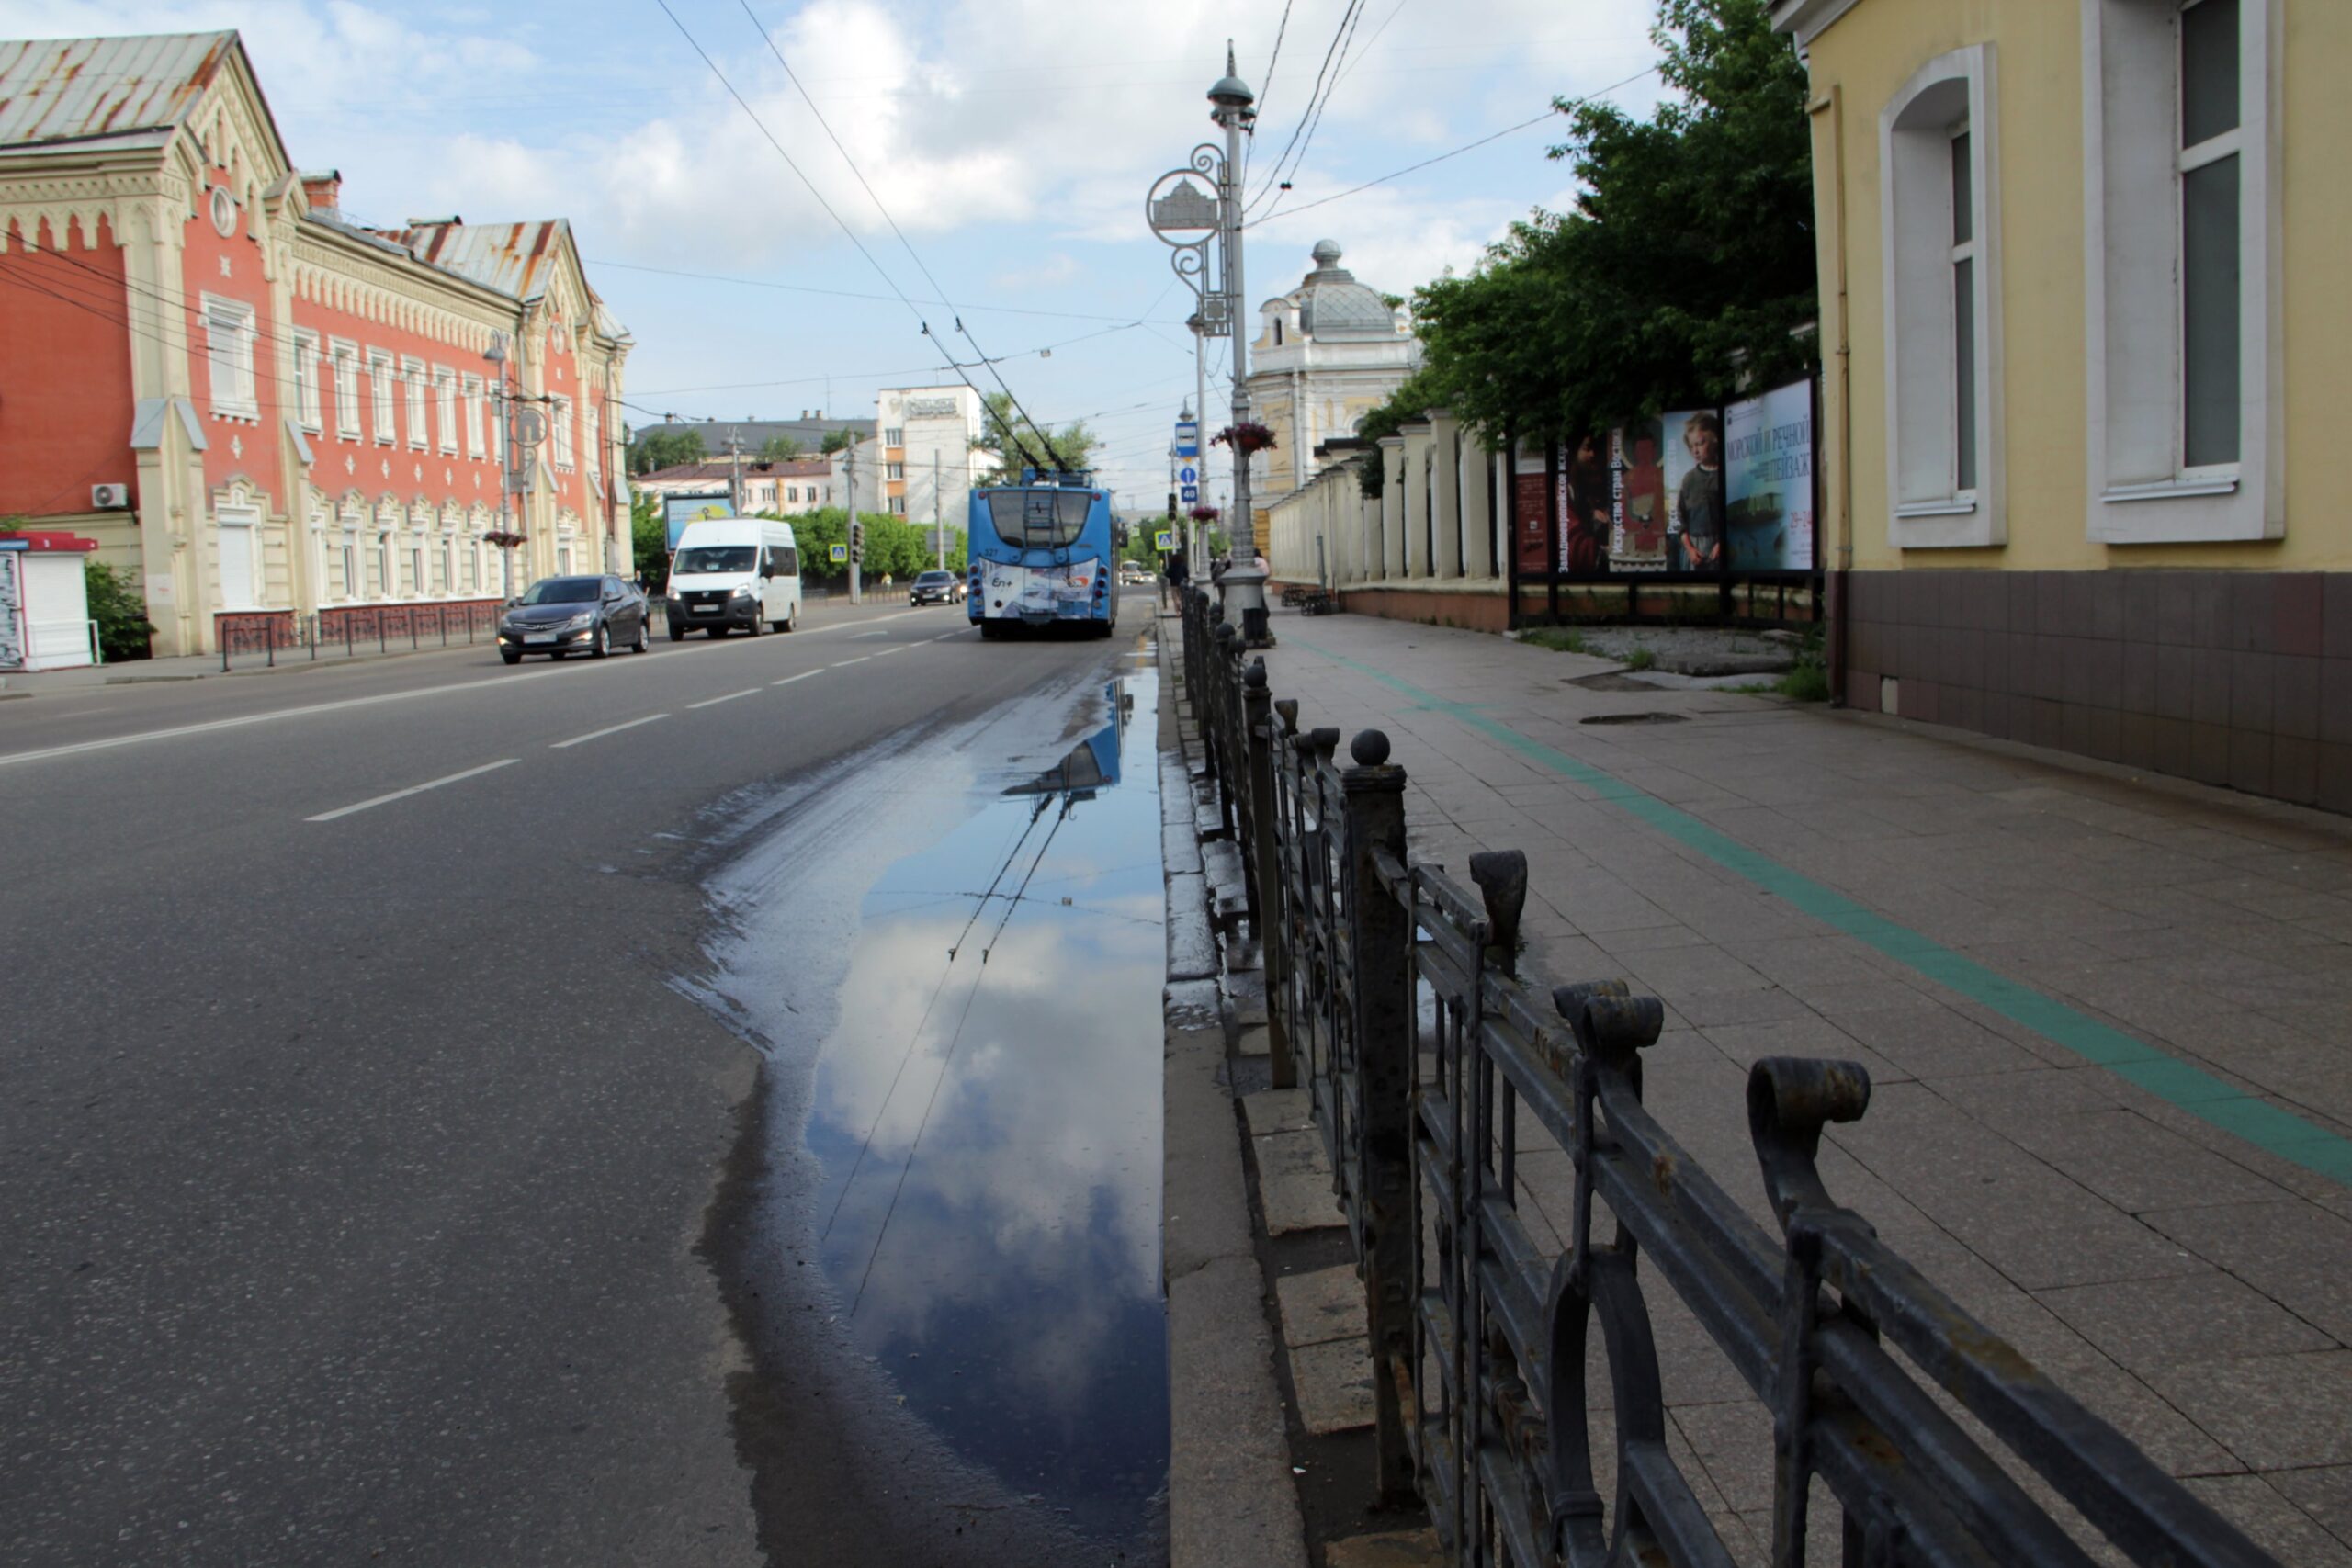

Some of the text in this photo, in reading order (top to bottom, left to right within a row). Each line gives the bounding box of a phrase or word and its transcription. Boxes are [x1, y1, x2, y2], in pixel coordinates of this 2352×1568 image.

[1772, 413, 1810, 451] РЕЧНОЙ
[1183, 490, 1195, 499] 40
[1611, 427, 1625, 554] Искусство стран Востока
